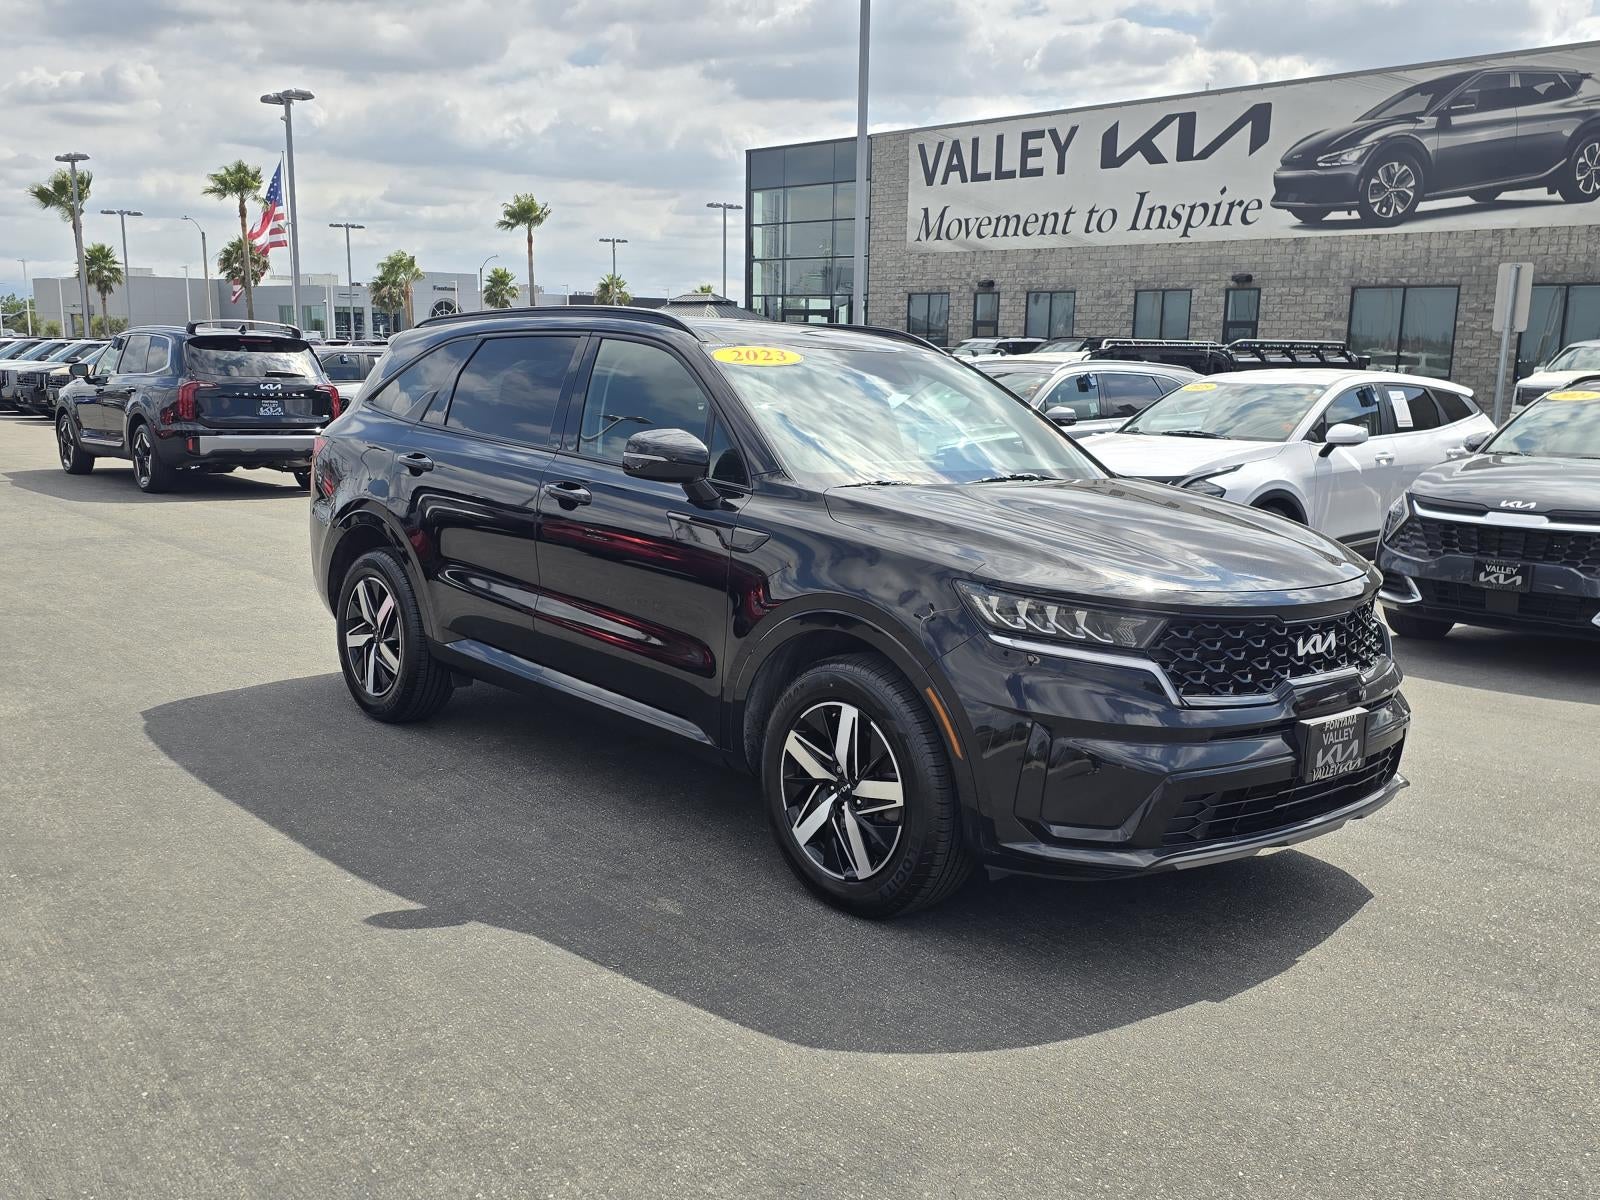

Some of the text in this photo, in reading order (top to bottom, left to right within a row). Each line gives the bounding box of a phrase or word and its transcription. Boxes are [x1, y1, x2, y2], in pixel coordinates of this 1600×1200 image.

[917, 102, 1272, 187] VALLEY KIA
[914, 185, 1263, 242] Movement to Inspire
[731, 350, 787, 361] 2023
[1500, 500, 1537, 509] KIA
[1479, 571, 1522, 586] KIA
[1485, 564, 1518, 575] VALLEY
[1297, 631, 1336, 656] KIA
[1324, 714, 1357, 732] FONTANA
[1322, 726, 1355, 746] VALLEY
[1316, 739, 1359, 768] KIA
